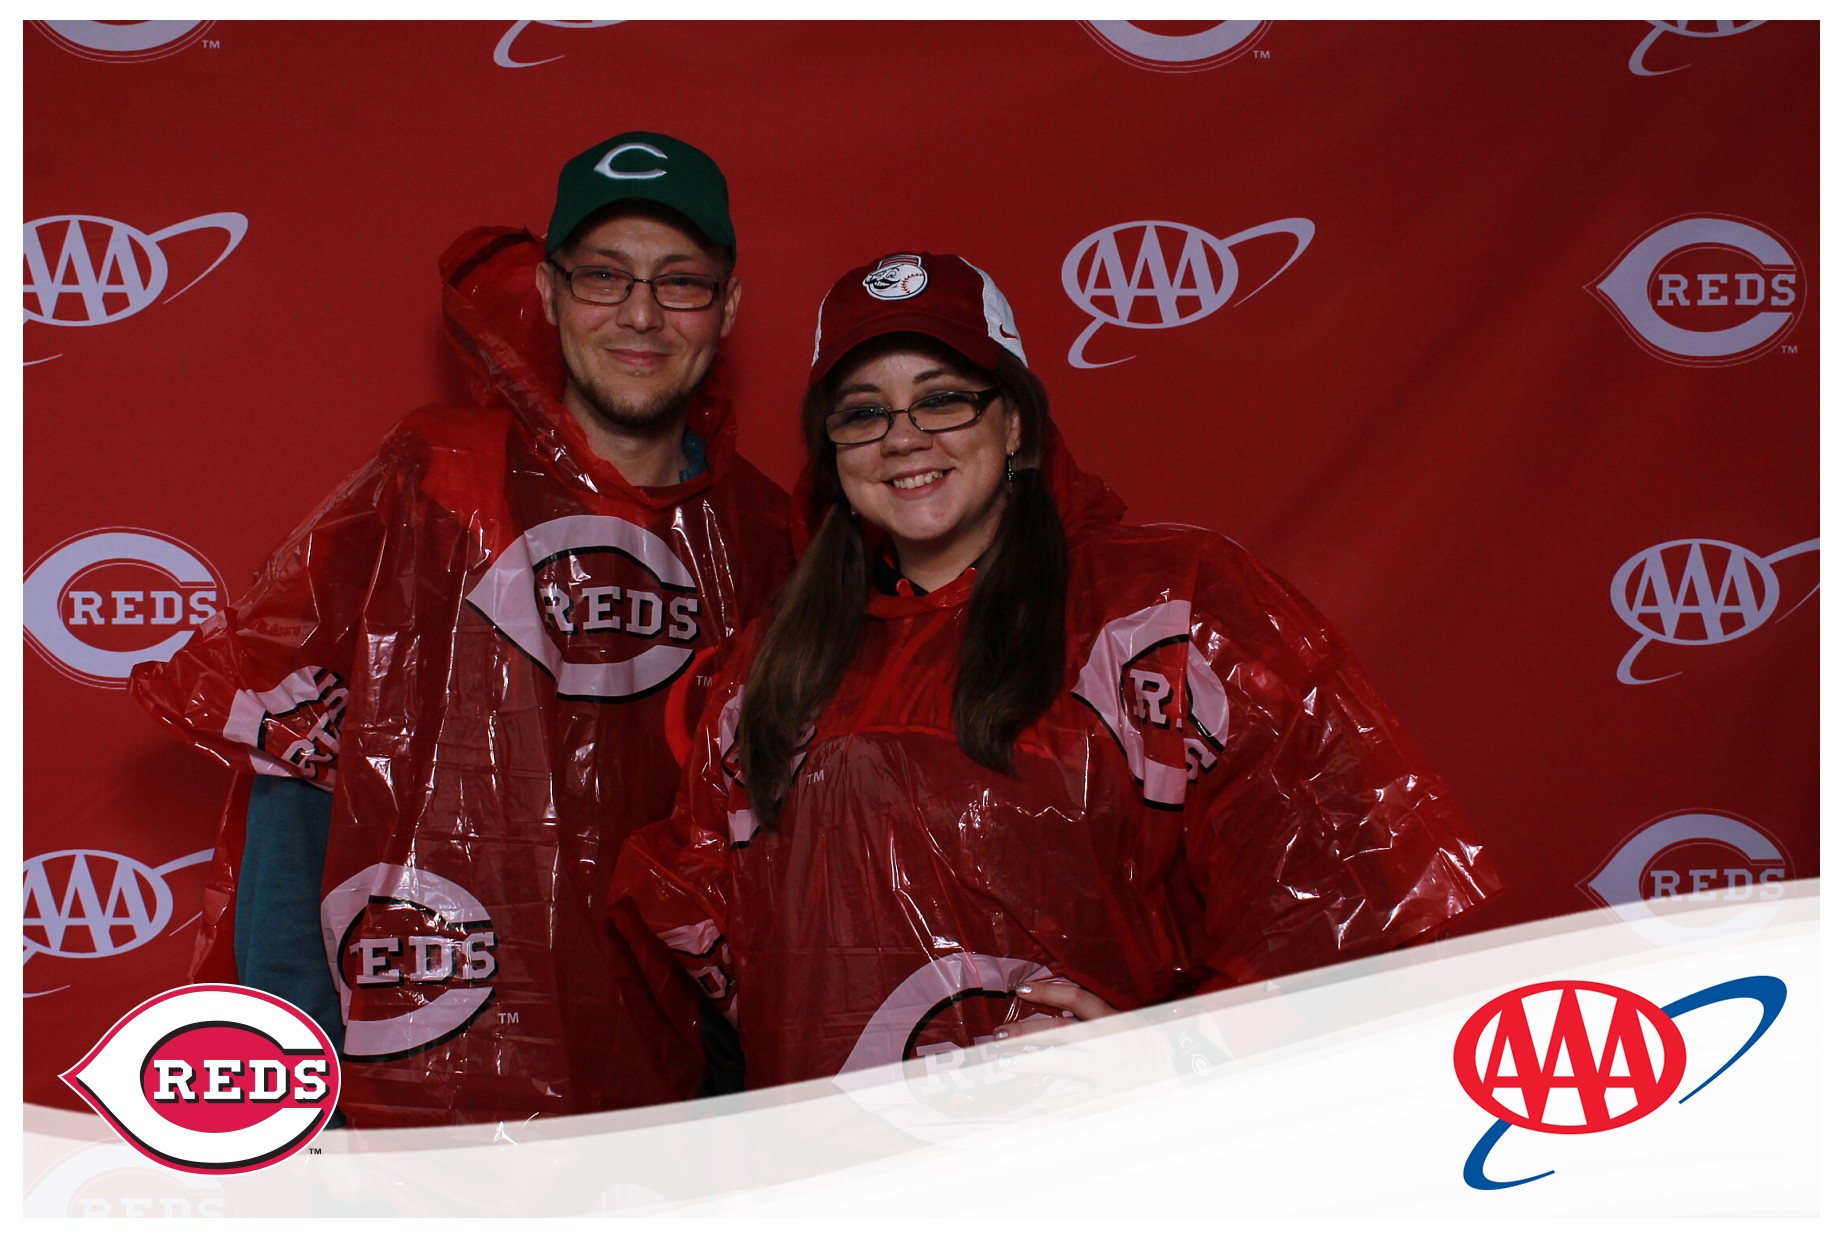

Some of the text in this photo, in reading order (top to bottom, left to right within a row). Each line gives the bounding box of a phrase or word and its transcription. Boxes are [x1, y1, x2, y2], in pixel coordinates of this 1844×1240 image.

[202, 39, 220, 50] TM
[1253, 50, 1271, 60] TM
[593, 141, 669, 180] C
[1078, 223, 1226, 326] AAA
[1656, 272, 1797, 307] REDS
[68, 590, 217, 626] REDS
[1627, 541, 1766, 644] AAA
[539, 585, 699, 643] REDS
[695, 675, 713, 688] TM
[806, 769, 825, 785] TM
[1649, 868, 1786, 903] REDS
[350, 930, 499, 986] EDS
[498, 1011, 520, 1025] TM
